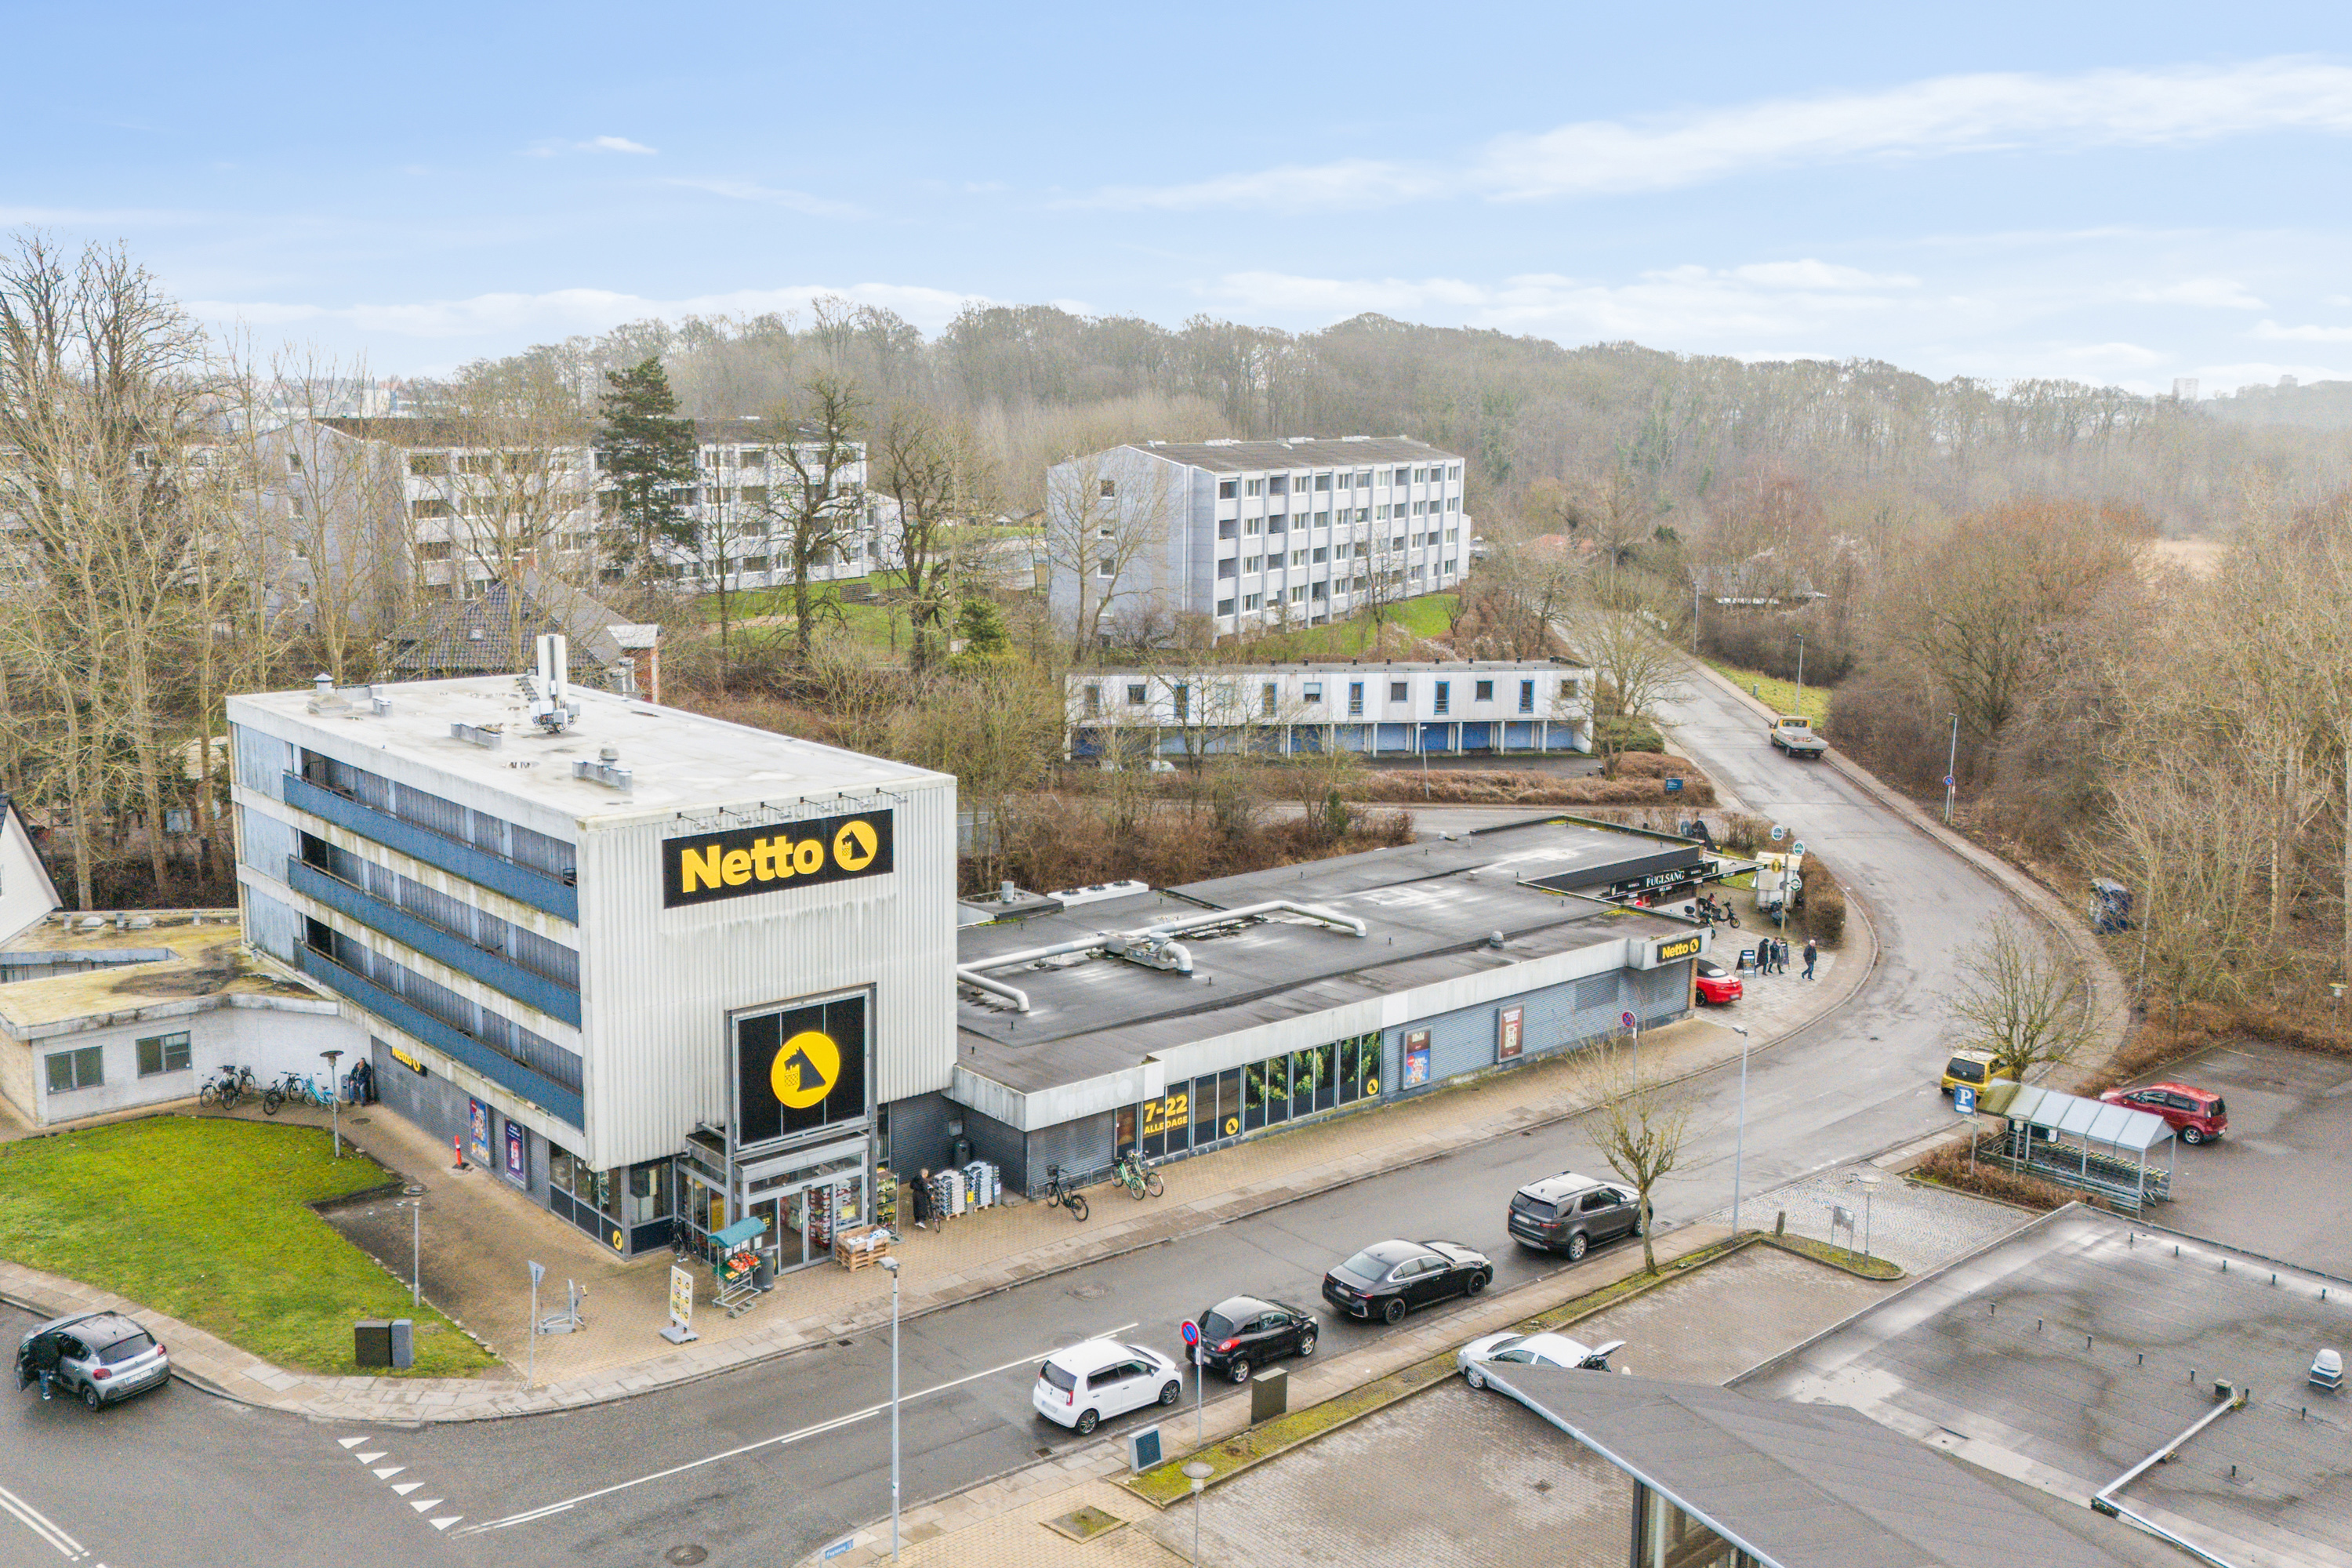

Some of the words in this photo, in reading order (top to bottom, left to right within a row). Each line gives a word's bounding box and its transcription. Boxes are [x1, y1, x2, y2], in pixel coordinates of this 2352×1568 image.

[681, 836, 824, 893] Netto
[1646, 870, 1685, 887] FUGLSANG
[1662, 943, 1689, 959] Netto
[1959, 1089, 1972, 1105] P
[1145, 1094, 1188, 1123] 7-22
[1144, 1122, 1164, 1134] ALLE
[1166, 1116, 1188, 1129] DAGE
